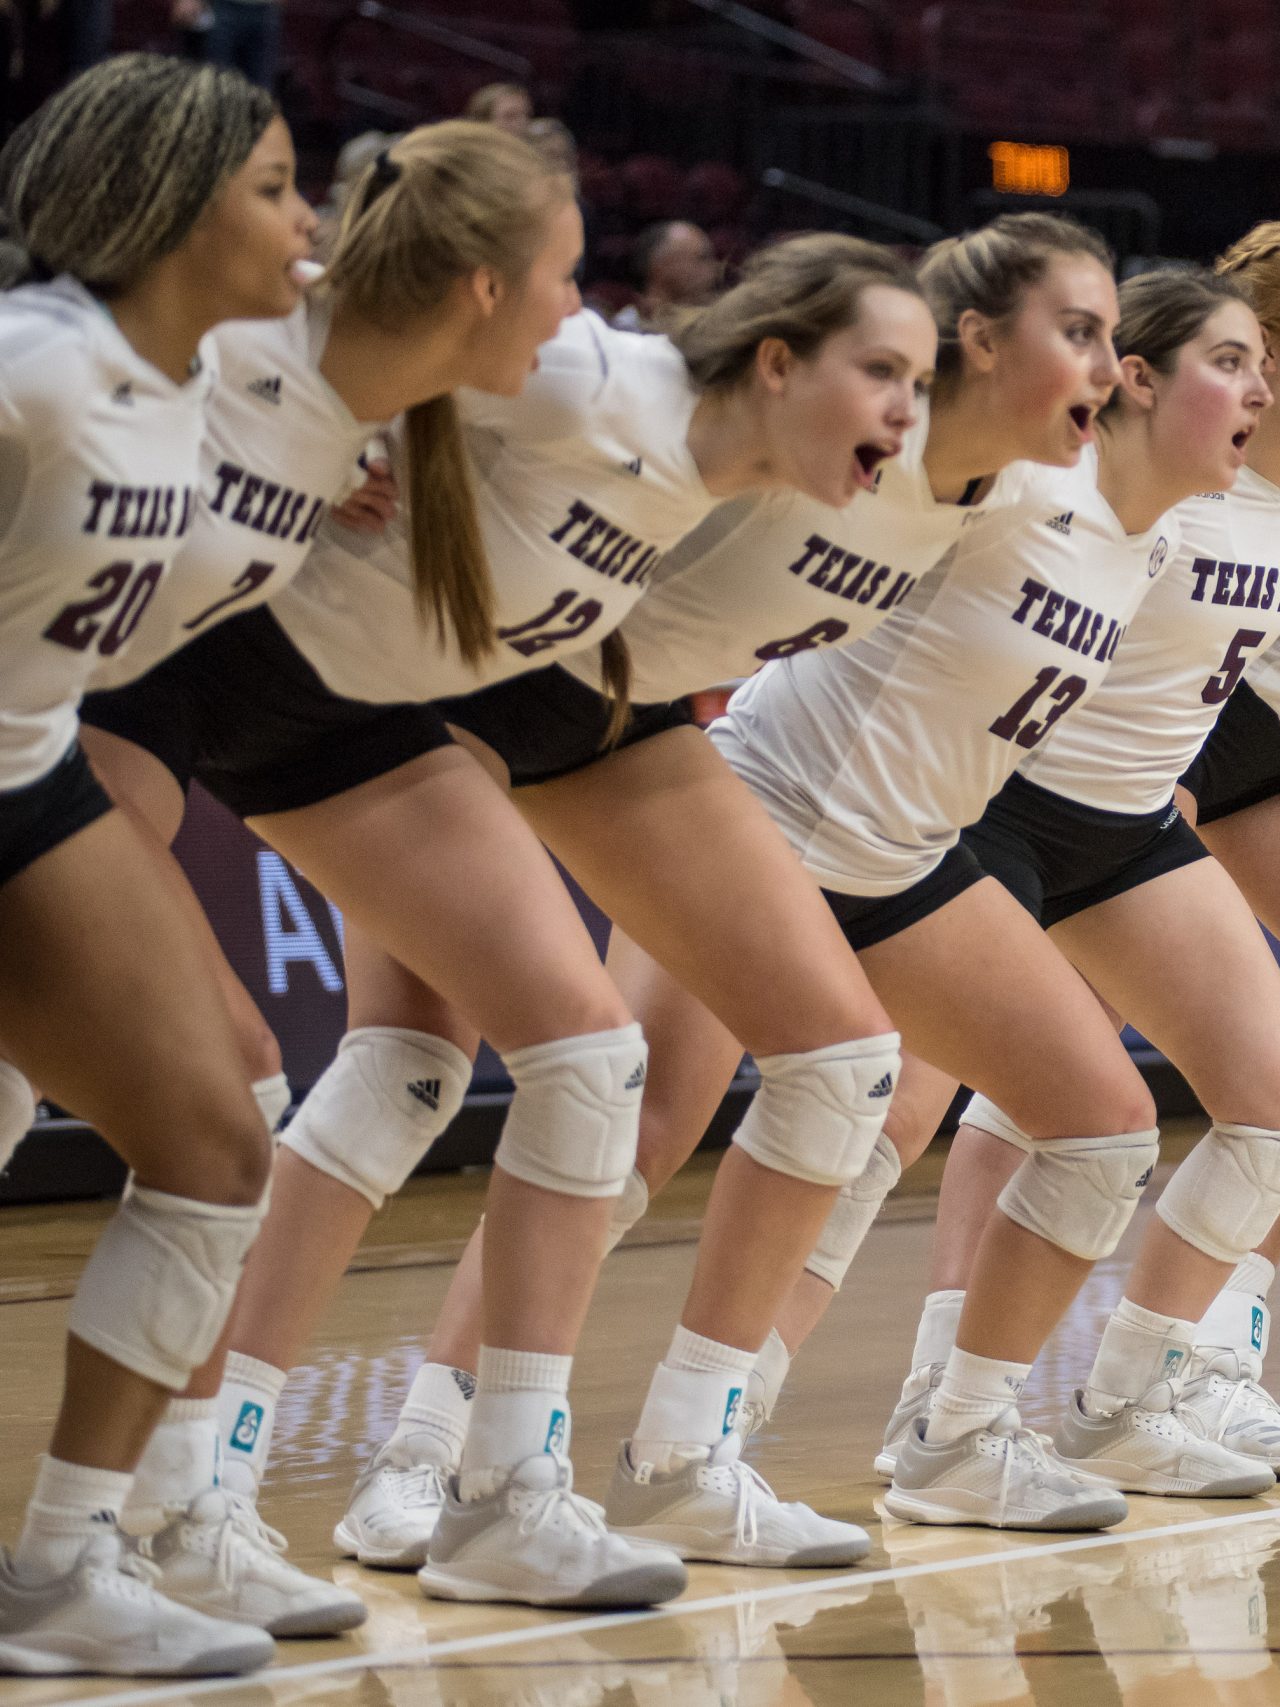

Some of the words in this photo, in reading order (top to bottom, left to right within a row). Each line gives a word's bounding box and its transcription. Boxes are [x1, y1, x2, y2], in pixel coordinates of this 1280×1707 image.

[82, 478, 176, 538] TEXAS
[209, 460, 308, 540] TEXAS
[548, 499, 643, 579] TEXAS
[788, 532, 892, 605] TEXAS
[42, 560, 165, 656] 20
[182, 559, 276, 630] 7
[1011, 577, 1105, 657] TEXAS
[1190, 556, 1280, 611] TEXAS
[496, 588, 604, 658] 12
[754, 616, 850, 662] 6
[1200, 628, 1268, 705] 5
[988, 665, 1088, 750] 13
[256, 850, 345, 995] A
